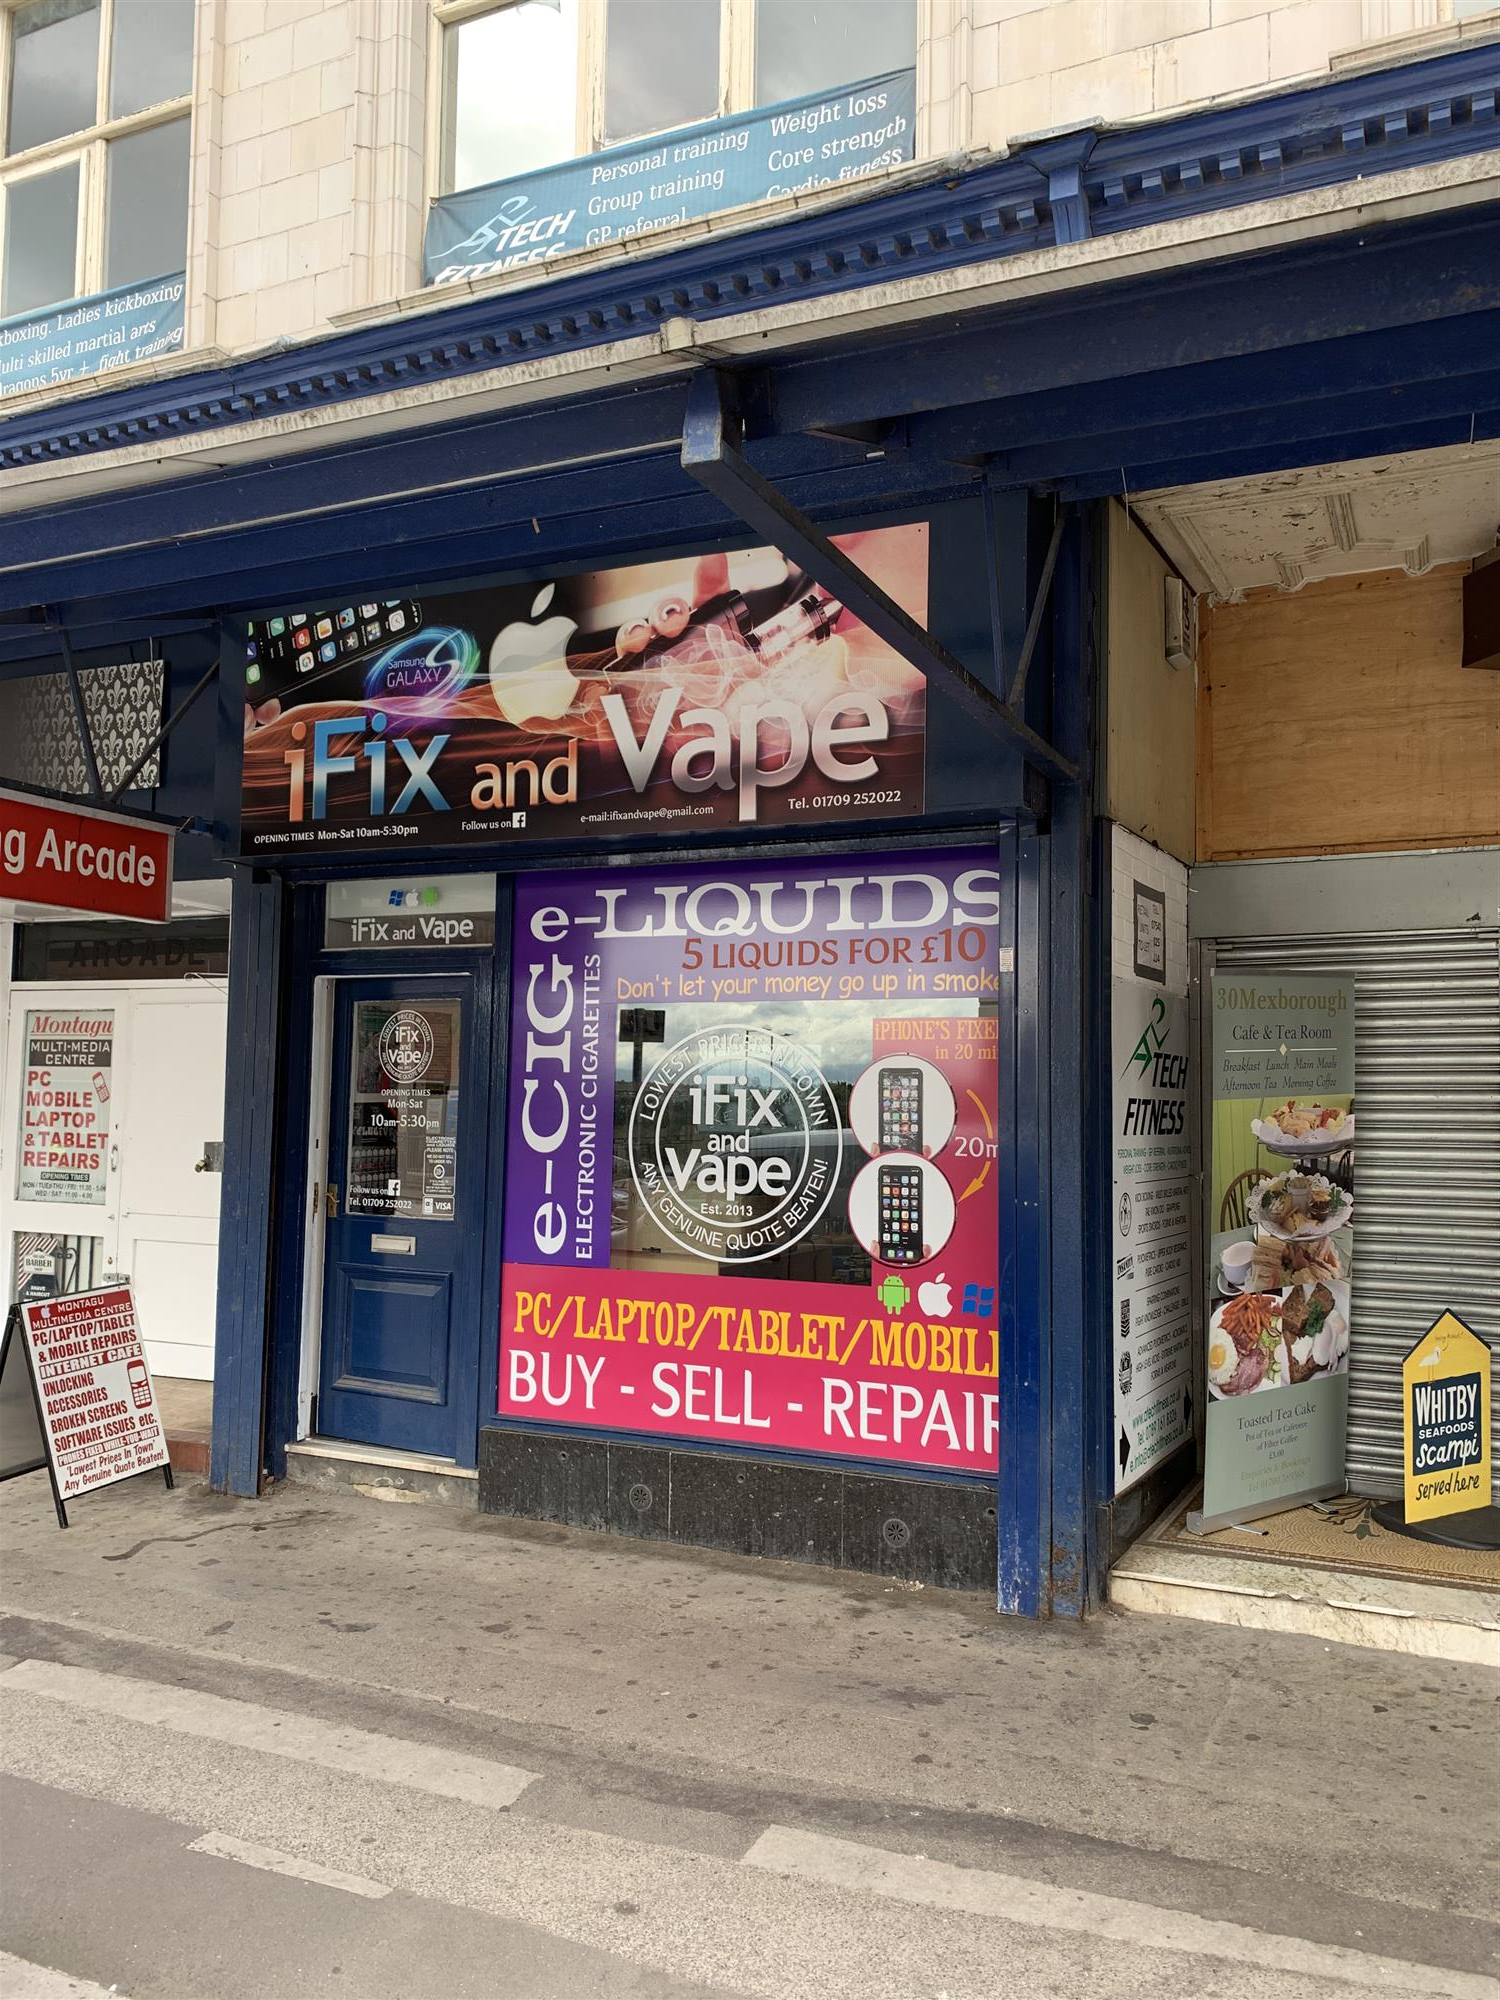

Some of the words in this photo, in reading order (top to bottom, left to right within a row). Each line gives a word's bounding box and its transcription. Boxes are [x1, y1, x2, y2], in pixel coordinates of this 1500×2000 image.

[770, 107, 840, 137] Weight
[848, 92, 886, 118] loss
[591, 150, 667, 186] Personal
[673, 130, 749, 165] training
[767, 146, 813, 172] Core
[820, 116, 906, 159] strength
[837, 148, 902, 184] fitness
[587, 190, 643, 223] Group
[649, 168, 724, 203] training
[495, 210, 576, 252] TECH
[585, 223, 611, 248] GP
[617, 209, 685, 240] referral
[57, 308, 101, 332] Ladies
[105, 283, 184, 317] kickboxing
[0, 353, 24, 376] ulti
[27, 341, 72, 367] skilled
[76, 325, 126, 354] martial
[130, 319, 156, 341] arts
[98, 351, 131, 374] fight
[135, 326, 184, 357] training
[387, 656, 426, 672] Samsung
[387, 669, 443, 688] GALAXY
[284, 712, 452, 823] iFix
[470, 737, 578, 810] and
[600, 686, 890, 822] Vape
[579, 804, 714, 824] e-mail:ifixandvape@gmail.com
[788, 796, 810, 810] Tel.
[812, 793, 851, 809] 01709
[853, 790, 902, 806] 252022
[254, 833, 289, 845] OPENING
[290, 831, 315, 842] TIMES
[317, 829, 355, 841] Mon-Sat
[355, 825, 419, 839] 10am-5:30pm
[461, 820, 488, 832] Follow
[488, 821, 499, 830] us
[500, 819, 511, 830] on
[36, 828, 156, 888] Arcade
[351, 917, 389, 942] iFix
[391, 925, 415, 941] and
[418, 917, 473, 944] Vape
[68, 938, 206, 969] ARCADE
[682, 938, 703, 970] 5
[713, 940, 839, 972] LIQUIDS
[849, 937, 911, 965] FOR
[921, 926, 987, 964] £10
[617, 975, 672, 999] Don't
[679, 973, 706, 996] let
[711, 975, 759, 1002] your
[765, 974, 829, 1002] money
[839, 976, 865, 998] go
[873, 974, 898, 996] up
[908, 969, 926, 991] in
[1217, 987, 1347, 1018] 30Mexborough
[30, 1015, 114, 1038] Montagu
[395, 1026, 420, 1043] iFix
[579, 954, 601, 1097] CIGARETTES
[874, 1020, 951, 1041] iPHONE'S
[956, 1019, 998, 1040] FIXE
[1262, 1025, 1273, 1040] &
[1275, 1025, 1297, 1040] Tea
[1299, 1024, 1332, 1040] Room
[45, 1054, 95, 1066] CENTRE
[388, 1048, 422, 1066] Vape
[935, 1045, 948, 1060] in
[955, 1044, 973, 1060] 20
[1222, 1057, 1261, 1074] Breakfast
[1266, 1056, 1290, 1071] Lunch
[1294, 1056, 1314, 1070] Main
[1316, 1054, 1338, 1069] Meals
[28, 1071, 51, 1087] PC
[1153, 1052, 1189, 1090] TECH
[1222, 1077, 1261, 1094] Afternoon
[1263, 1076, 1278, 1089] Tea
[1282, 1075, 1315, 1091] Morning
[1316, 1074, 1338, 1090] Coffee
[26, 1091, 92, 1109] MOBILE
[381, 1089, 410, 1097] OPENING
[411, 1088, 431, 1097] TIMES
[639, 1046, 690, 1122] LOWEST
[795, 1062, 829, 1126] TOWN
[387, 1098, 424, 1110] Mon-Sat
[688, 1074, 783, 1129] iFix
[26, 1111, 95, 1129] LAPTOP
[371, 1113, 440, 1131] 10am-5:30pm
[1123, 1098, 1186, 1137] FITNESS
[24, 1134, 35, 1147] &
[38, 1132, 109, 1150] TABLET
[707, 1129, 749, 1154] and
[23, 1150, 100, 1170] REPAIRS
[664, 1146, 792, 1202] Vape
[42, 1172, 69, 1180] OPENING
[71, 1173, 89, 1181] TIMES
[349, 1184, 371, 1194] Follow
[575, 1104, 598, 1261] ELECTRONIC
[362, 1198, 384, 1207] 01709
[384, 1199, 412, 1209] 252022
[435, 1201, 452, 1210] VISA
[641, 1159, 666, 1193] ANY
[658, 1198, 722, 1249] GENUINE
[726, 1224, 787, 1251] QUOTE
[781, 1159, 830, 1229] BEATEN!
[700, 1203, 722, 1216] Est.
[725, 1204, 753, 1217] 2013
[25, 1258, 53, 1268] BARBER
[32, 1311, 93, 1330] MULTIMEDIA
[94, 1302, 132, 1318] CENTRE
[57, 1295, 105, 1312] MONTAGU
[32, 1313, 135, 1346] PC/LAPTOP/TABLET
[38, 1351, 47, 1364] &
[48, 1340, 90, 1360] MOBILE
[91, 1329, 137, 1350] REPAIRS
[40, 1353, 105, 1379] INTERNET
[107, 1344, 142, 1363] CAFE
[43, 1371, 95, 1397] UNLOCKING
[508, 1349, 606, 1410] BUY
[650, 1361, 771, 1429] SELL
[47, 1387, 109, 1417] ACCESSORIES
[1237, 1409, 1273, 1431] Toasted
[1275, 1408, 1293, 1421] Tea
[1294, 1401, 1318, 1417] Cake
[1415, 1383, 1478, 1427] WHITBY
[50, 1412, 87, 1433] BROKEN
[88, 1400, 128, 1425] SCREENS
[1418, 1421, 1476, 1440] SEAFOODS
[54, 1425, 102, 1452] SOFTWARE
[104, 1416, 136, 1437] ISSUES
[139, 1411, 157, 1427] etc.
[58, 1449, 84, 1467] PHONES
[98, 1453, 123, 1470] Prices
[1416, 1432, 1479, 1469] Scampi
[64, 1478, 82, 1492] Any
[82, 1468, 113, 1485] Genuine
[113, 1461, 138, 1477] Quote
[137, 1448, 165, 1467] Beaten!
[1415, 1471, 1453, 1502] served
[1454, 1474, 1480, 1494] here
